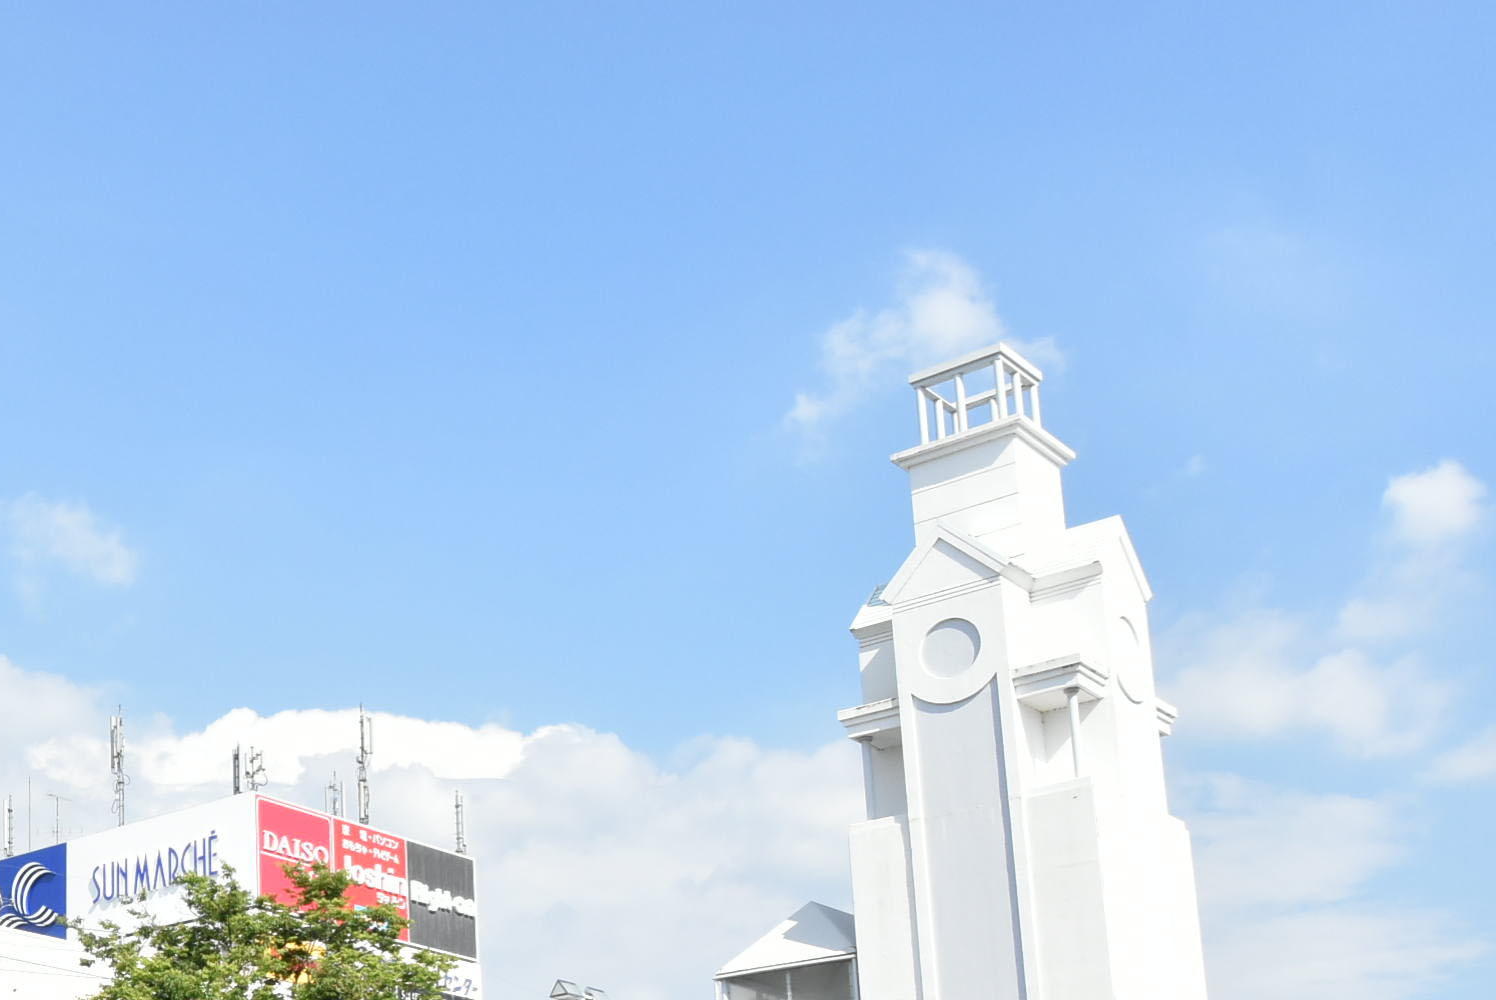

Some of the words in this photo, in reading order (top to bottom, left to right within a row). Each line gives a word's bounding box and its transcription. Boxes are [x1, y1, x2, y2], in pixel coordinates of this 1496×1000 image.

[262, 829, 329, 863] DAISO
[92, 858, 128, 904] SUN
[343, 854, 408, 897] Joshin
